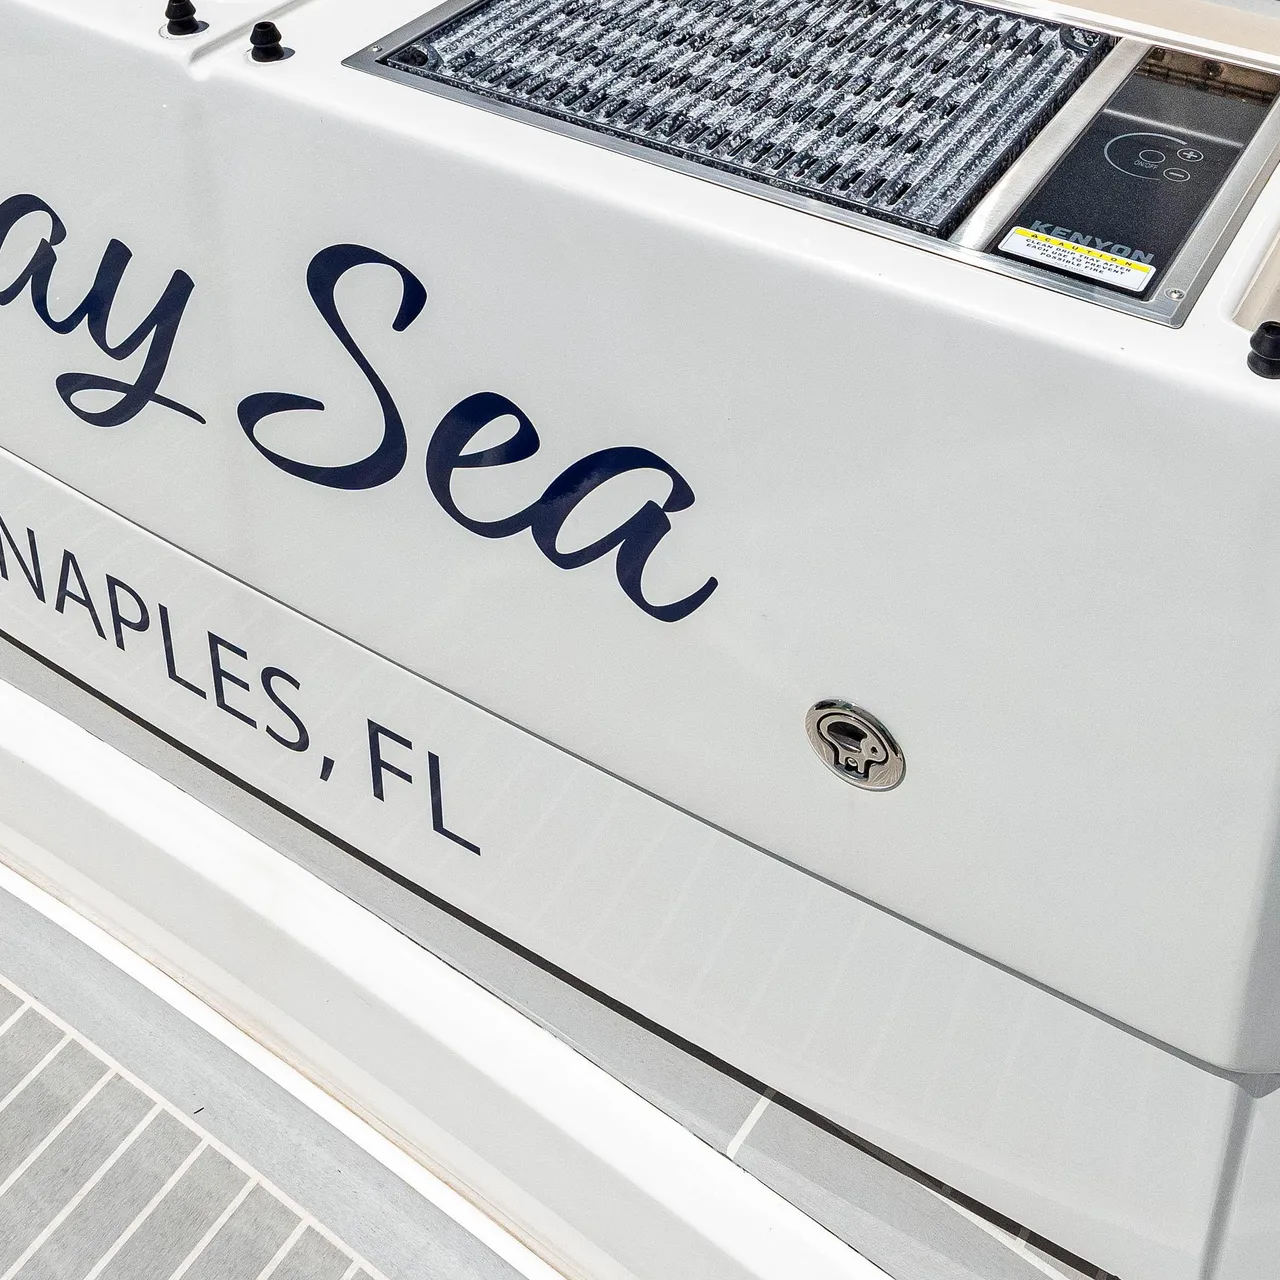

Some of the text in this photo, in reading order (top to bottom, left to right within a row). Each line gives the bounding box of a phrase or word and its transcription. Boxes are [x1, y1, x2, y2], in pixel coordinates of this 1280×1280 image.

[1134, 160, 1158, 169] ON/OFF
[1026, 239, 1053, 249] CLEAN
[1056, 247, 1076, 255] DRIP
[1104, 262, 1132, 272] AFTER
[1030, 220, 1154, 264] KENYON
[1045, 238, 1132, 266] CAUTION
[1026, 244, 1048, 252] EACH
[1085, 261, 1125, 275] PREVENT
[1040, 252, 1082, 267] POSSIBLE
[1085, 266, 1104, 274] FIRE
[237, 244, 718, 622] Sea
[368, 719, 480, 856] FL
